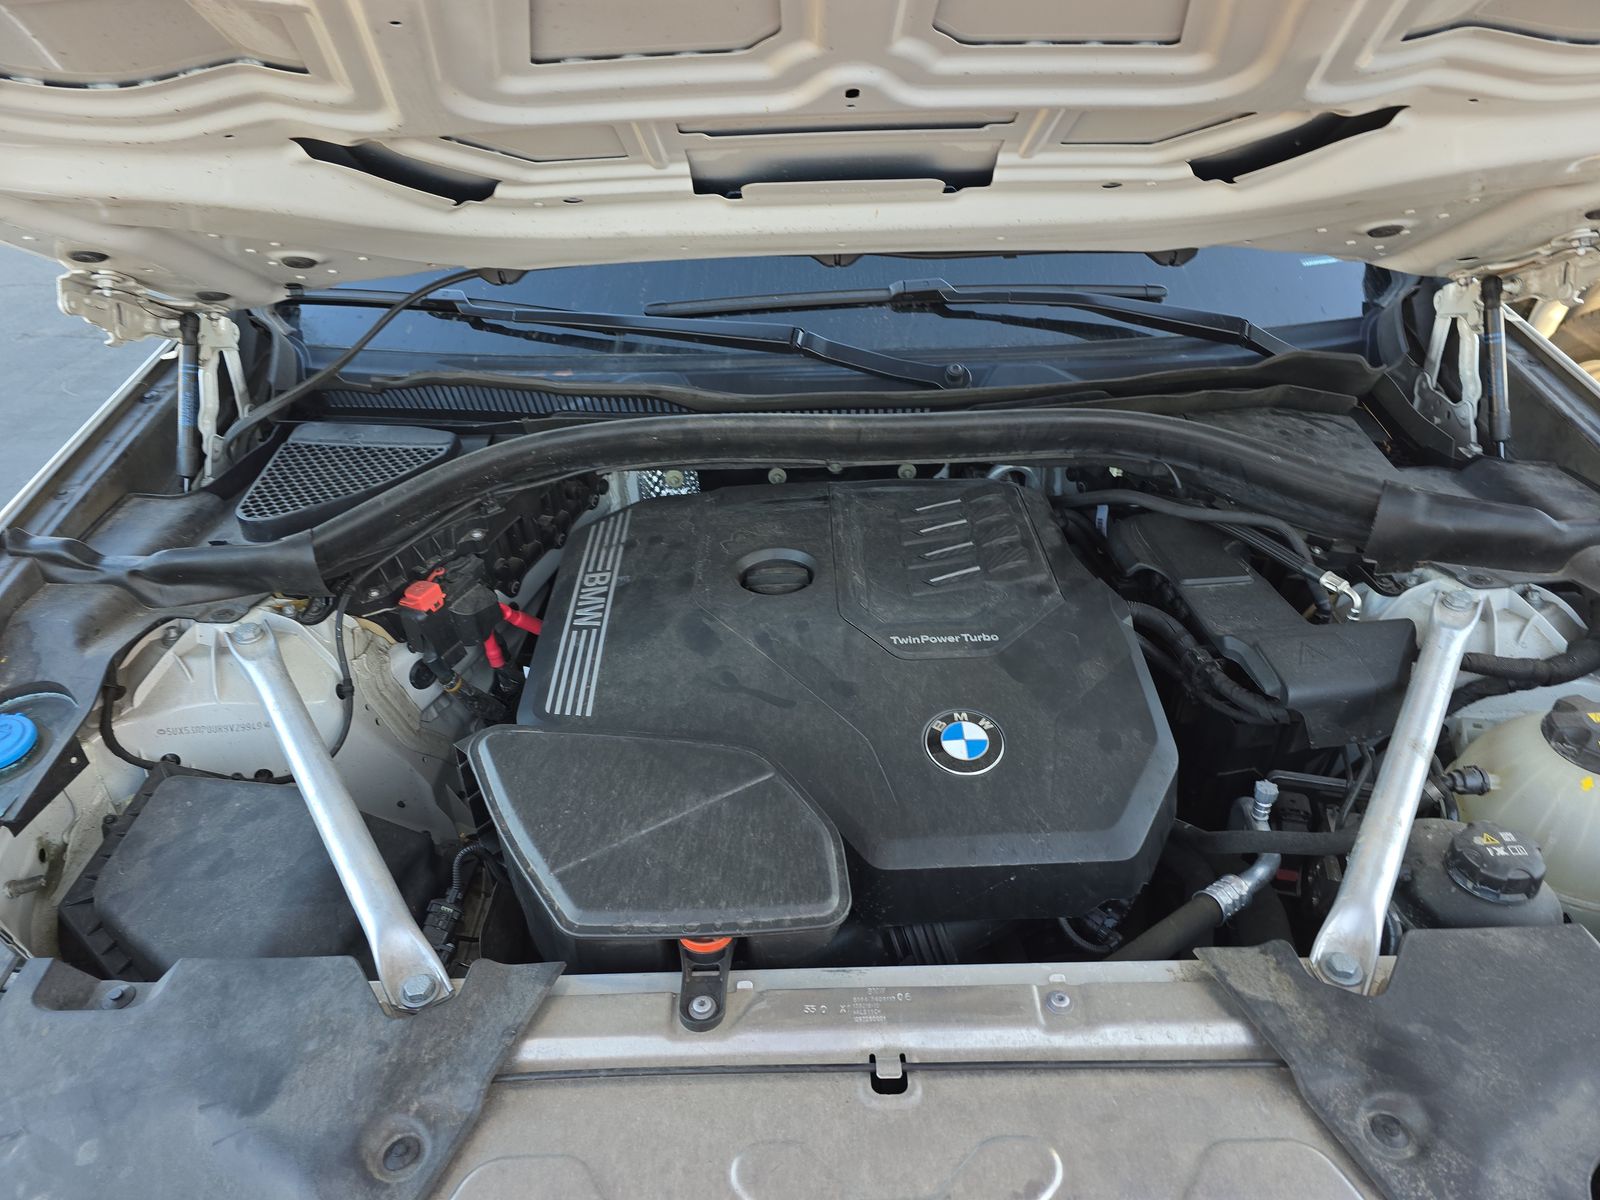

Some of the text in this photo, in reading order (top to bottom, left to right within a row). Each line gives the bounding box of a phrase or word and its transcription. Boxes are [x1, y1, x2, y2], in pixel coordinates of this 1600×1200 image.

[573, 571, 612, 627] BMW
[890, 632, 1000, 645] TwinPower Turbo
[931, 712, 995, 732] BMW
